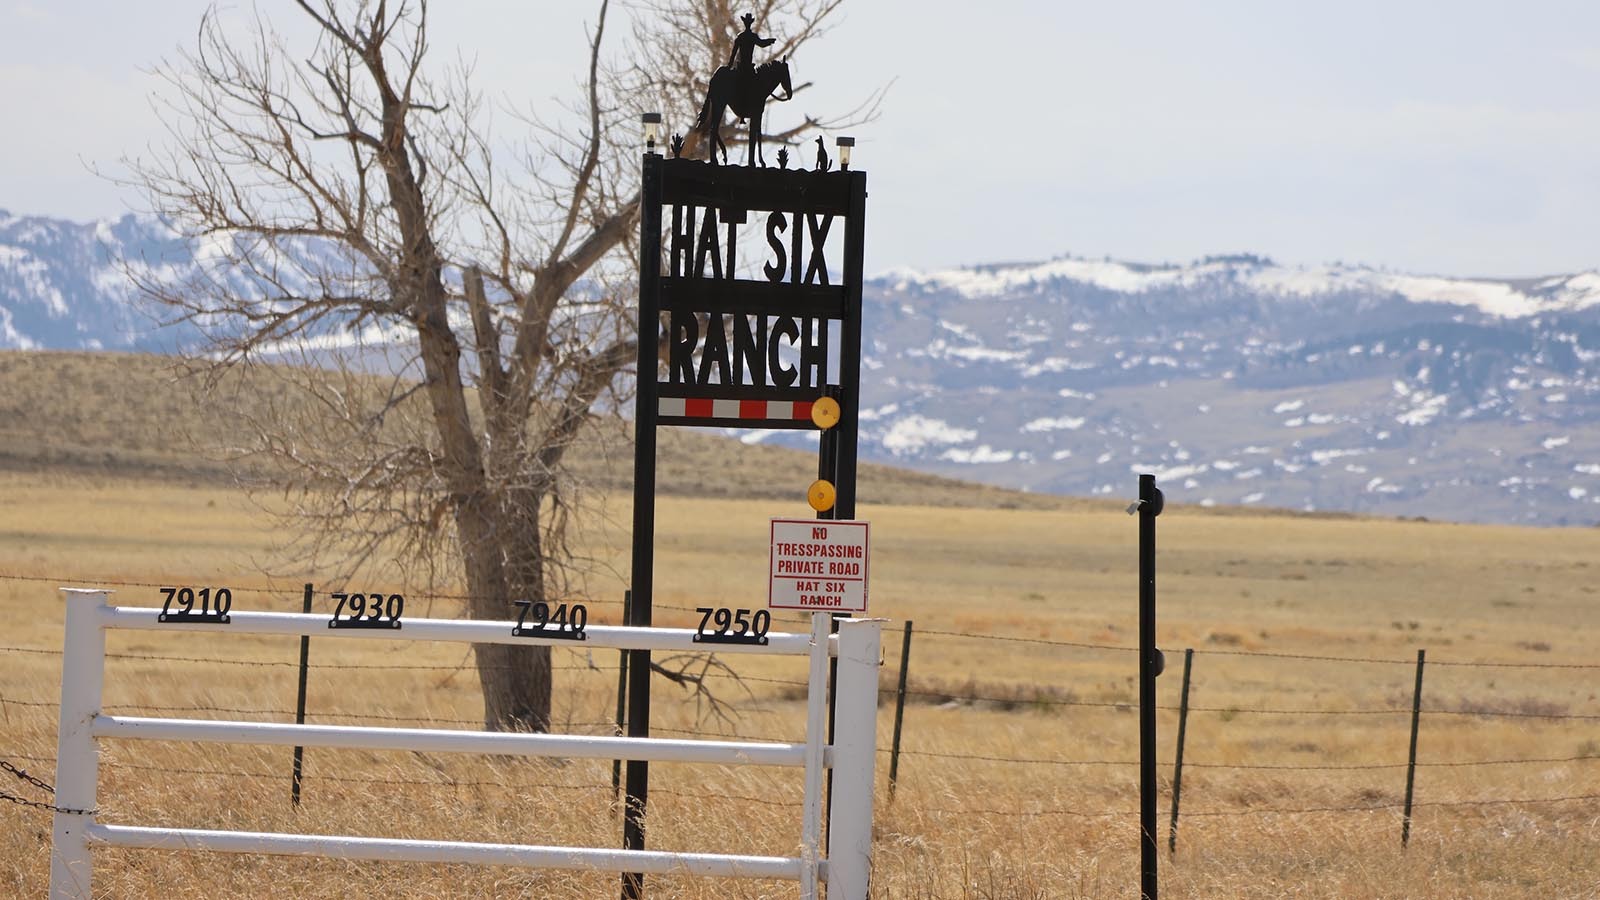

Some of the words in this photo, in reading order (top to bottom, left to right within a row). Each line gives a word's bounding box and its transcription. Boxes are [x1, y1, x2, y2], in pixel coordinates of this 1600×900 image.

[671, 205, 747, 280] HAT
[764, 210, 833, 285] SIX
[669, 311, 828, 388] RANCH
[812, 527, 828, 540] NO
[777, 543, 862, 558] TRESSPASSING
[778, 560, 824, 574] PRIVATE
[829, 562, 859, 575] ROAD
[796, 581, 820, 591] HAT
[825, 582, 845, 593] SIX
[800, 595, 841, 606] RANCH
[159, 588, 232, 616] 7910
[331, 593, 404, 621] 7930
[514, 601, 587, 631] 7940
[696, 607, 771, 637] 7950
